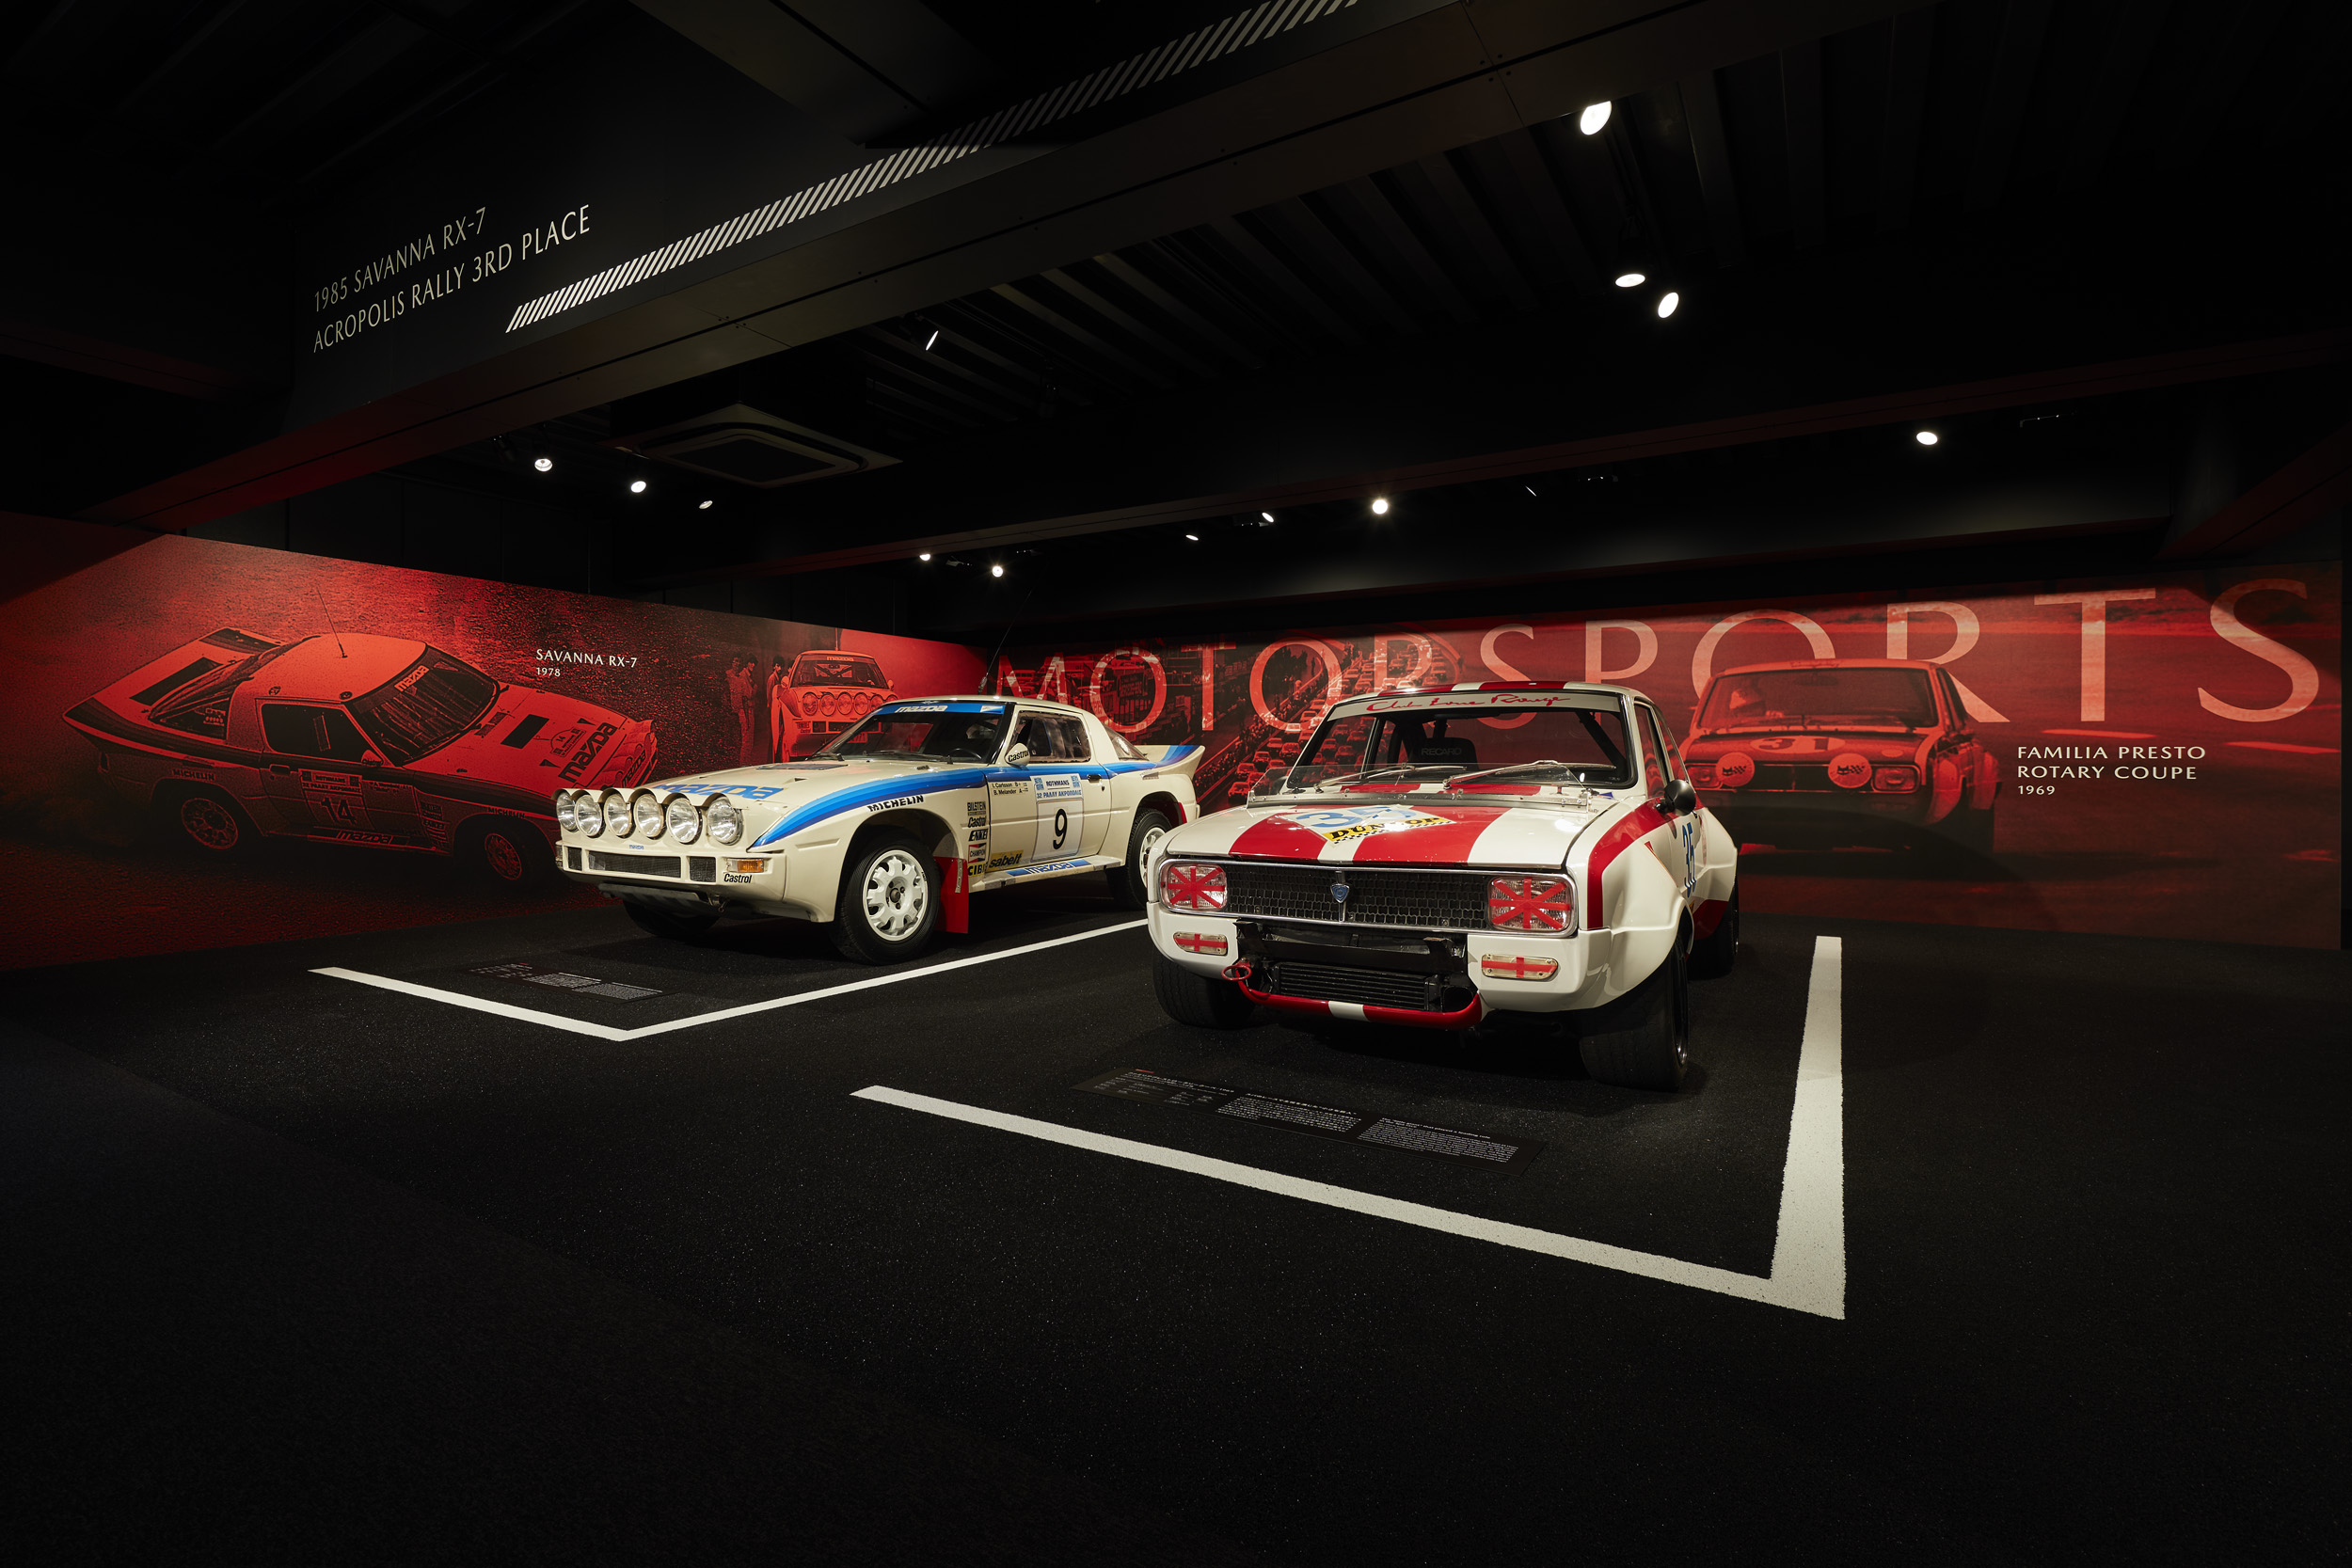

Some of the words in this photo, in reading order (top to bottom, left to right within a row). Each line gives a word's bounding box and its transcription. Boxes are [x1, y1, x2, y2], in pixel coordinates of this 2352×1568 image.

[314, 276, 348, 312] 1985
[354, 233, 436, 293] SAVANNA
[443, 206, 486, 250] RX-7
[313, 291, 405, 354] ACROPOLIS
[412, 262, 465, 309] RALLY
[472, 242, 513, 282] 3RD
[522, 204, 591, 261] PLACE
[535, 648, 604, 666] SAVANNA
[609, 655, 638, 668] RX-7
[535, 667, 561, 677] 1978
[1758, 737, 1830, 751] 31
[1008, 750, 1029, 763] Castro
[1422, 747, 1463, 756] RECARO
[2017, 746, 2108, 759] FAMILIA
[2118, 746, 2206, 760] PRESTO
[172, 768, 215, 781] MICHELIN
[2017, 766, 2106, 779] ROTARY
[2114, 766, 2198, 780] COUPE
[2018, 784, 2056, 796] 1969
[321, 796, 358, 825] 14
[867, 795, 925, 813] MICHELIN
[1053, 808, 1068, 850] 9
[1330, 816, 1441, 840] DUNOP
[990, 852, 1023, 869] sabelt
[723, 873, 753, 884] Castrol
